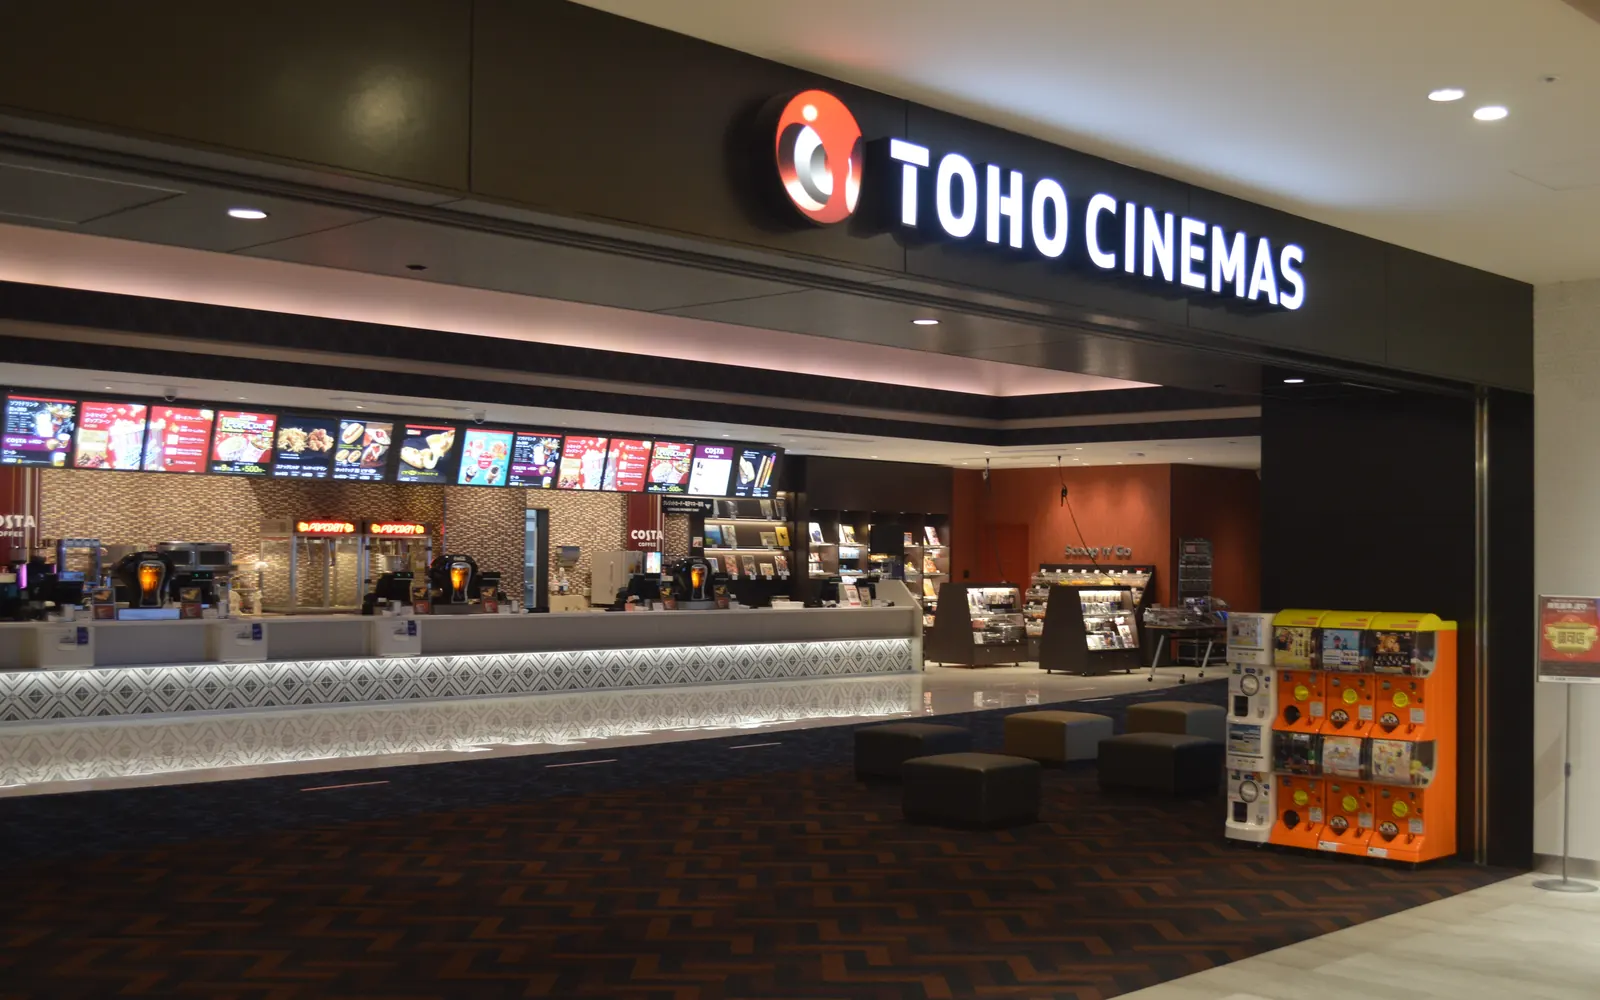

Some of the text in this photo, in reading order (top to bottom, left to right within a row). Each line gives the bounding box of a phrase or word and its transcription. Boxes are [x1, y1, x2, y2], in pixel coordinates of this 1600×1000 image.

[889, 138, 1306, 311] TOHO CINEMAS
[704, 447, 725, 455] COSTA
[307, 522, 345, 532] POPCORN
[380, 524, 416, 534] POPCORN
[631, 529, 664, 541] COSTA
[1065, 544, 1099, 557] Scoop
[1115, 545, 1132, 557] Go
